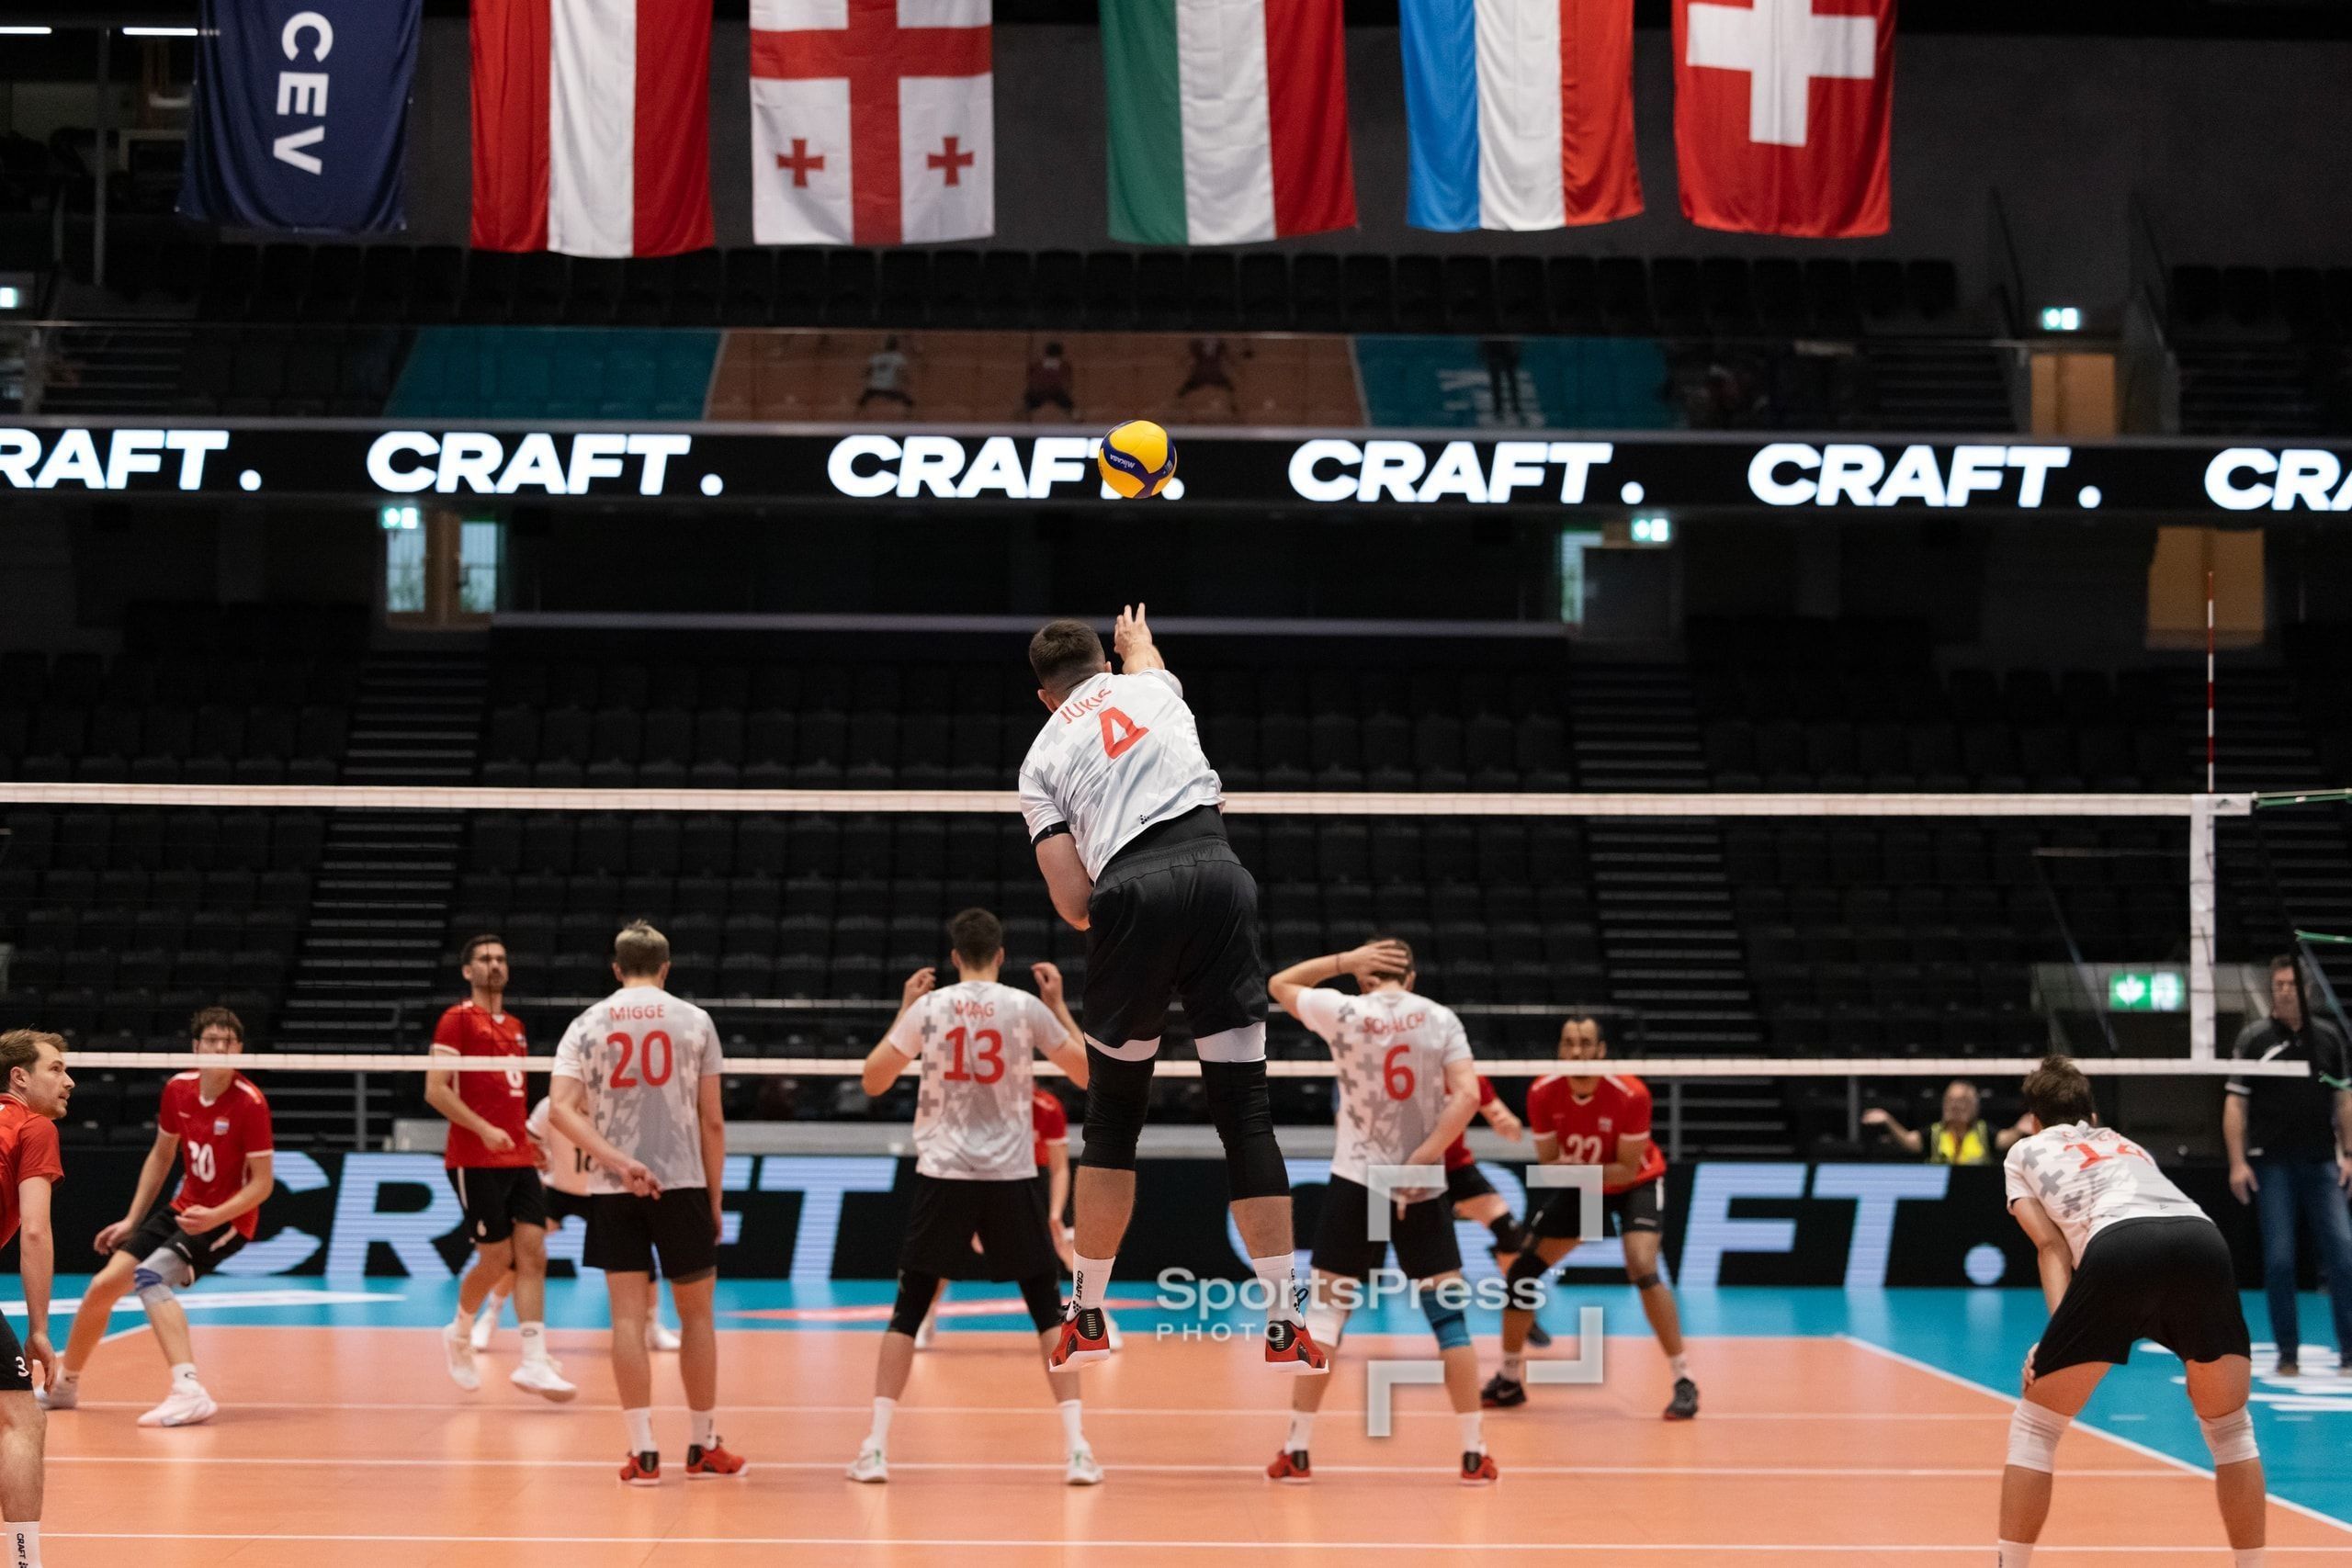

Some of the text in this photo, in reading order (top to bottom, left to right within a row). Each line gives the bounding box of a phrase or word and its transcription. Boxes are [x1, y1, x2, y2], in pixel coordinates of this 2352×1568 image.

[273, 11, 334, 175] CEV
[828, 434, 1185, 501] CRAF.
[2204, 447, 2352, 511] CR
[1098, 706, 1149, 760] 4
[609, 1004, 665, 1021] MIGGE
[606, 1031, 673, 1089] 20
[944, 1026, 1005, 1085] 13
[1384, 1044, 1415, 1101] 6
[1076, 1269, 1084, 1300] CRAFT
[15, 1355, 30, 1377] 3
[17, 1532, 27, 1560] CRAFT
